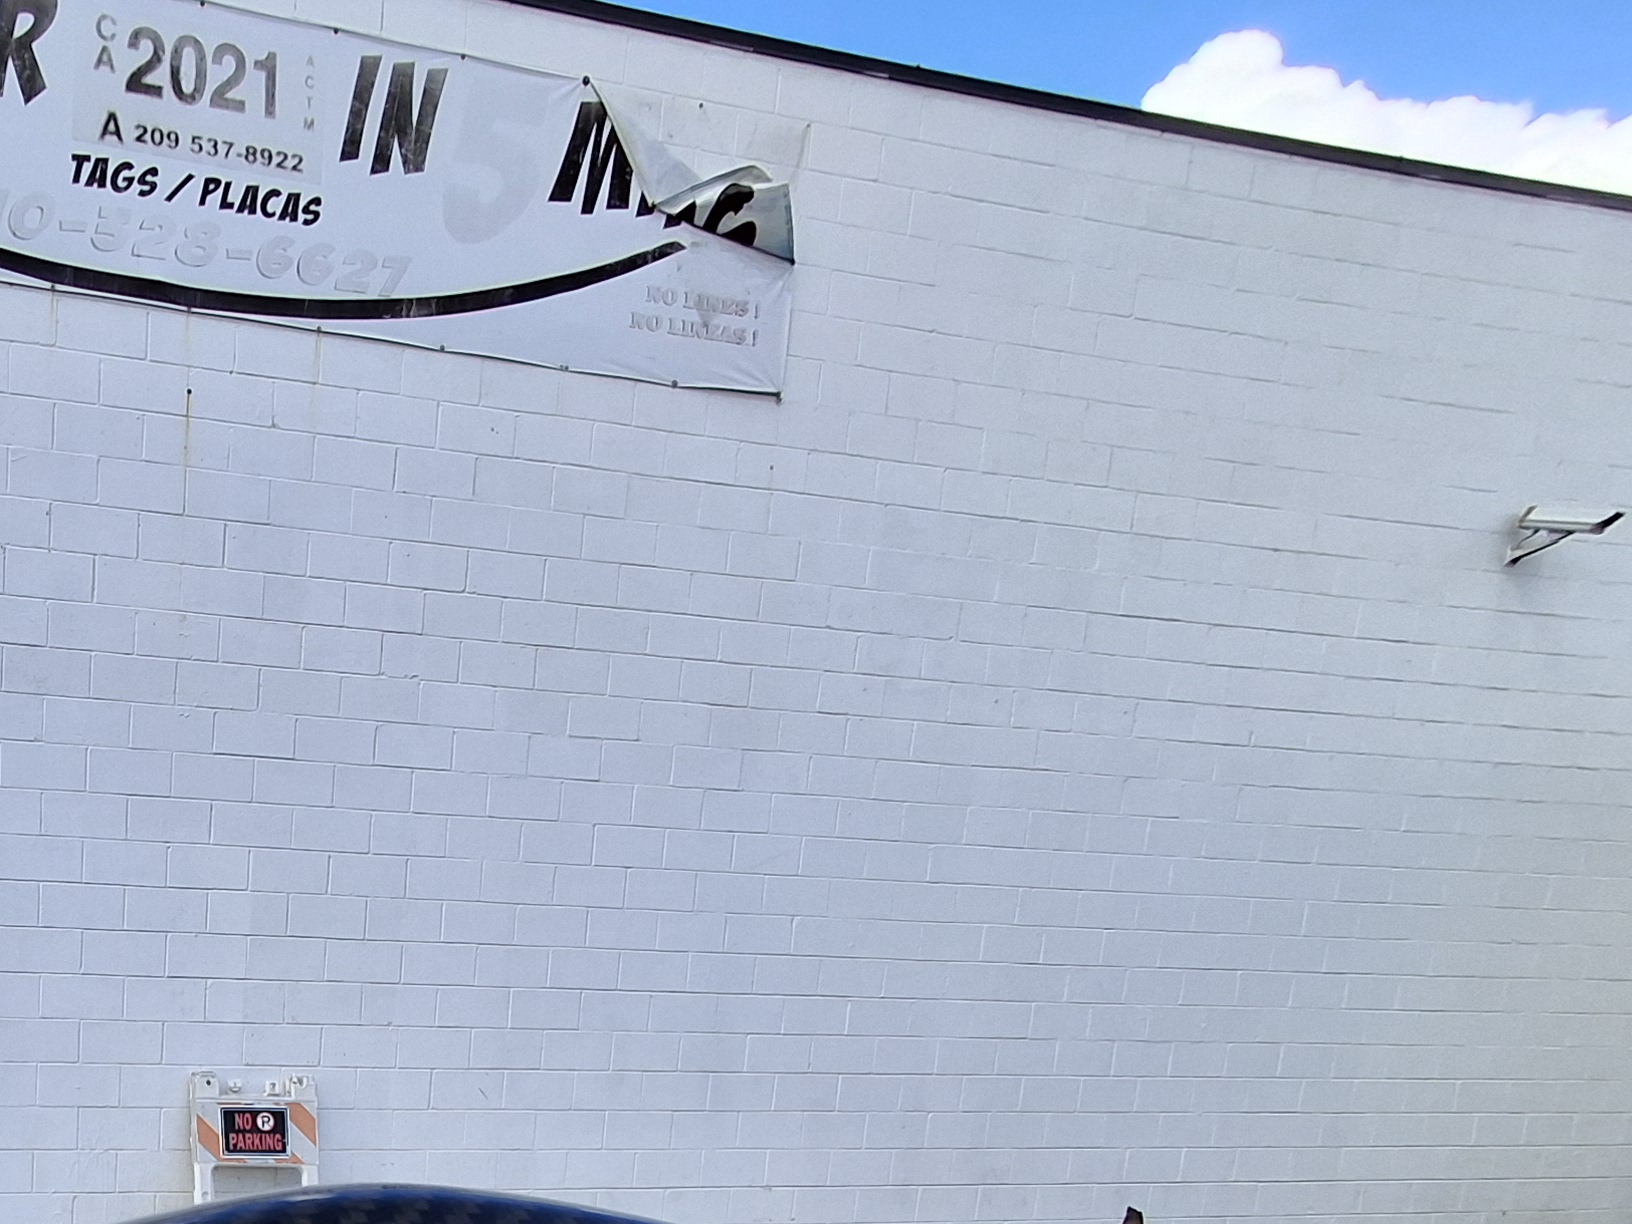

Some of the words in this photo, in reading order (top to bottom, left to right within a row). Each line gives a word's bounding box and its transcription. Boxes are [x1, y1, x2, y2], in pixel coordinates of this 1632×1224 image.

[125, 26, 278, 120] 2021
[98, 110, 124, 145] A
[134, 123, 180, 149] 209
[190, 135, 304, 173] 537-8922
[339, 55, 449, 175] IN
[71, 153, 159, 197] TAGS
[198, 175, 324, 227] PLACAS
[229, 1133, 283, 1150] PARKING
[234, 1113, 252, 1130] NO
